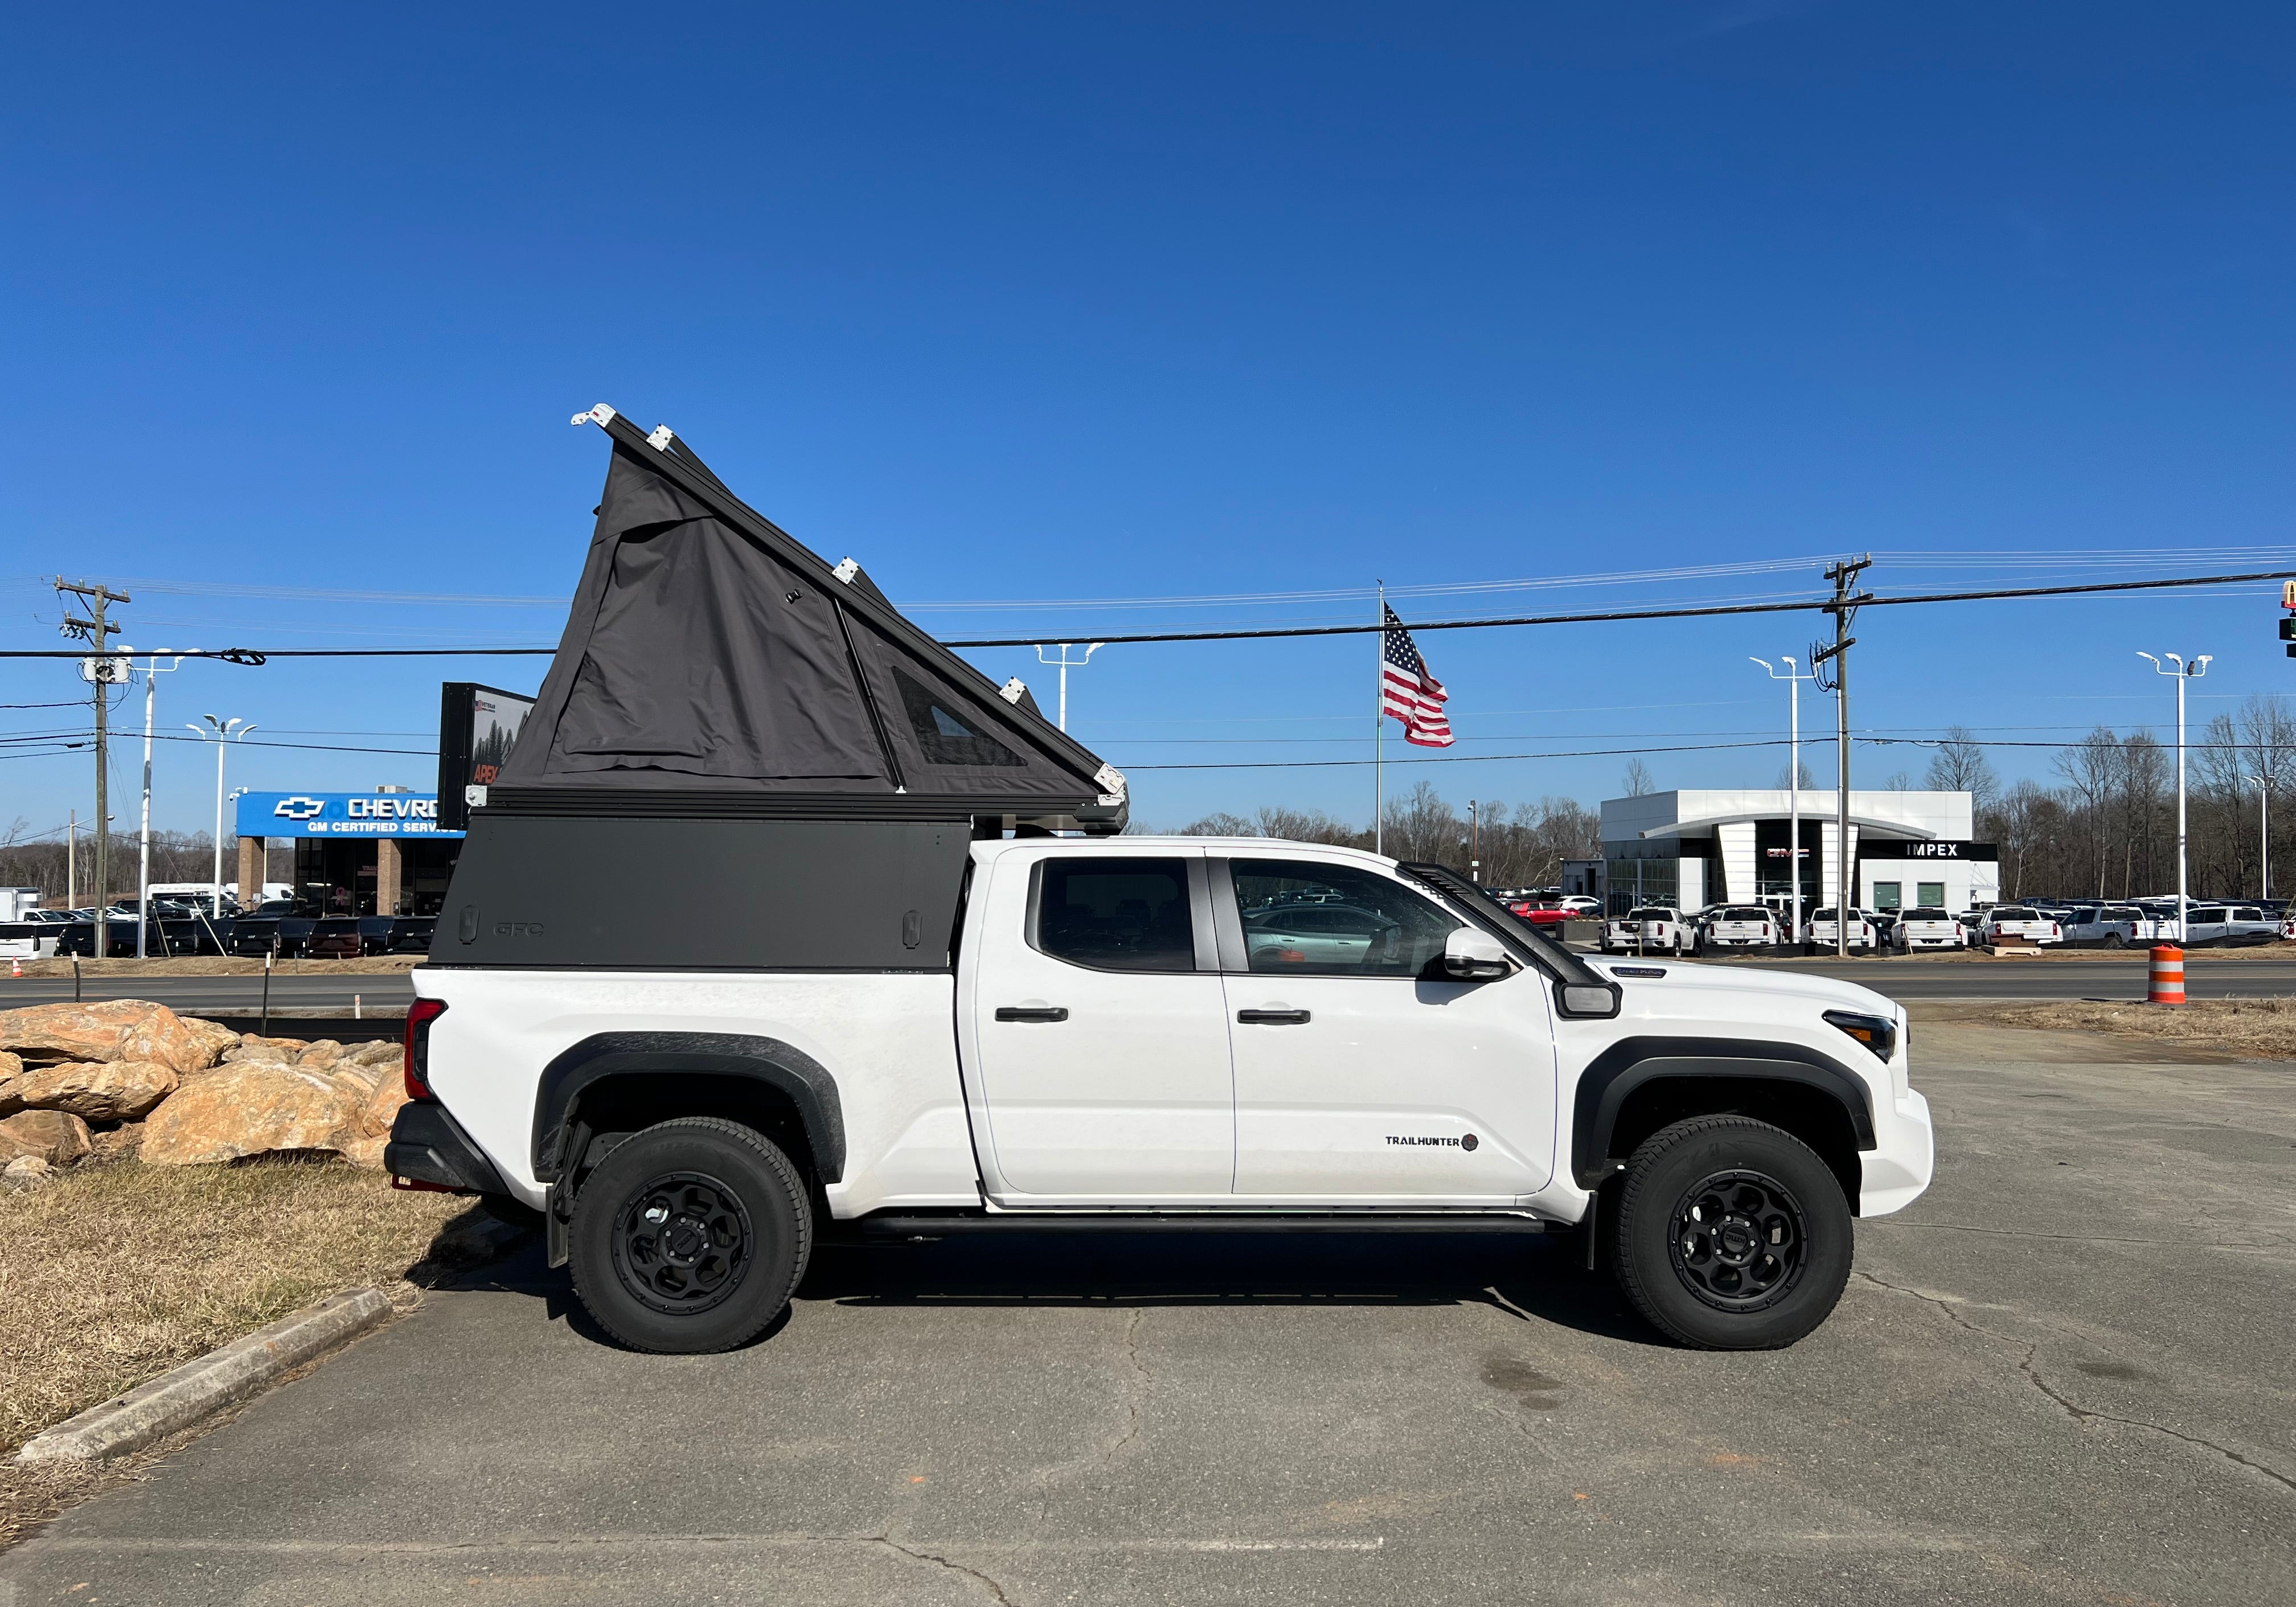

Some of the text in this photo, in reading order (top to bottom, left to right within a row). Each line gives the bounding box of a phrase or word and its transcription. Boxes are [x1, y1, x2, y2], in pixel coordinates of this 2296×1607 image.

[473, 764, 498, 784] APEX
[308, 822, 458, 833] GM CERTIFIED SERV
[1906, 844, 1958, 856] IMPEX
[493, 922, 544, 937] GFC
[1385, 1136, 1459, 1146] TRAILHUNTER
